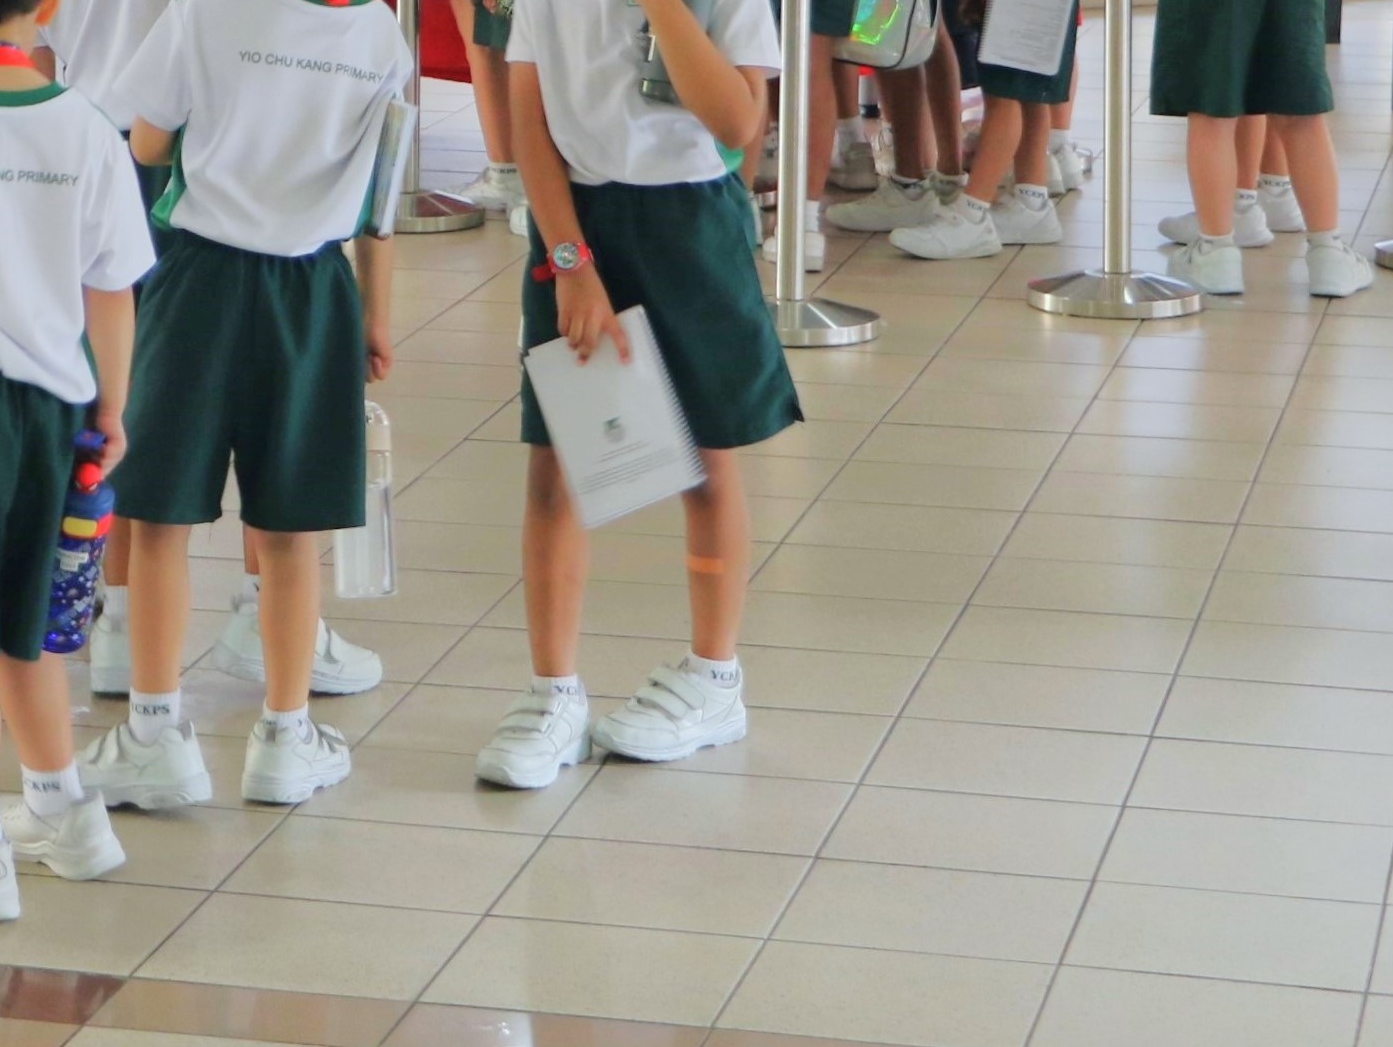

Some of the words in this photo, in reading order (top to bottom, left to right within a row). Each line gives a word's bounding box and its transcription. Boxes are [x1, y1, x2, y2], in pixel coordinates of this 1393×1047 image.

[239, 50, 262, 64] YIO
[264, 53, 293, 68] CHU
[296, 58, 332, 73] KANG
[335, 62, 385, 83] PRIMARY
[16, 169, 80, 187] PRIMARY
[131, 704, 170, 715] CKPS
